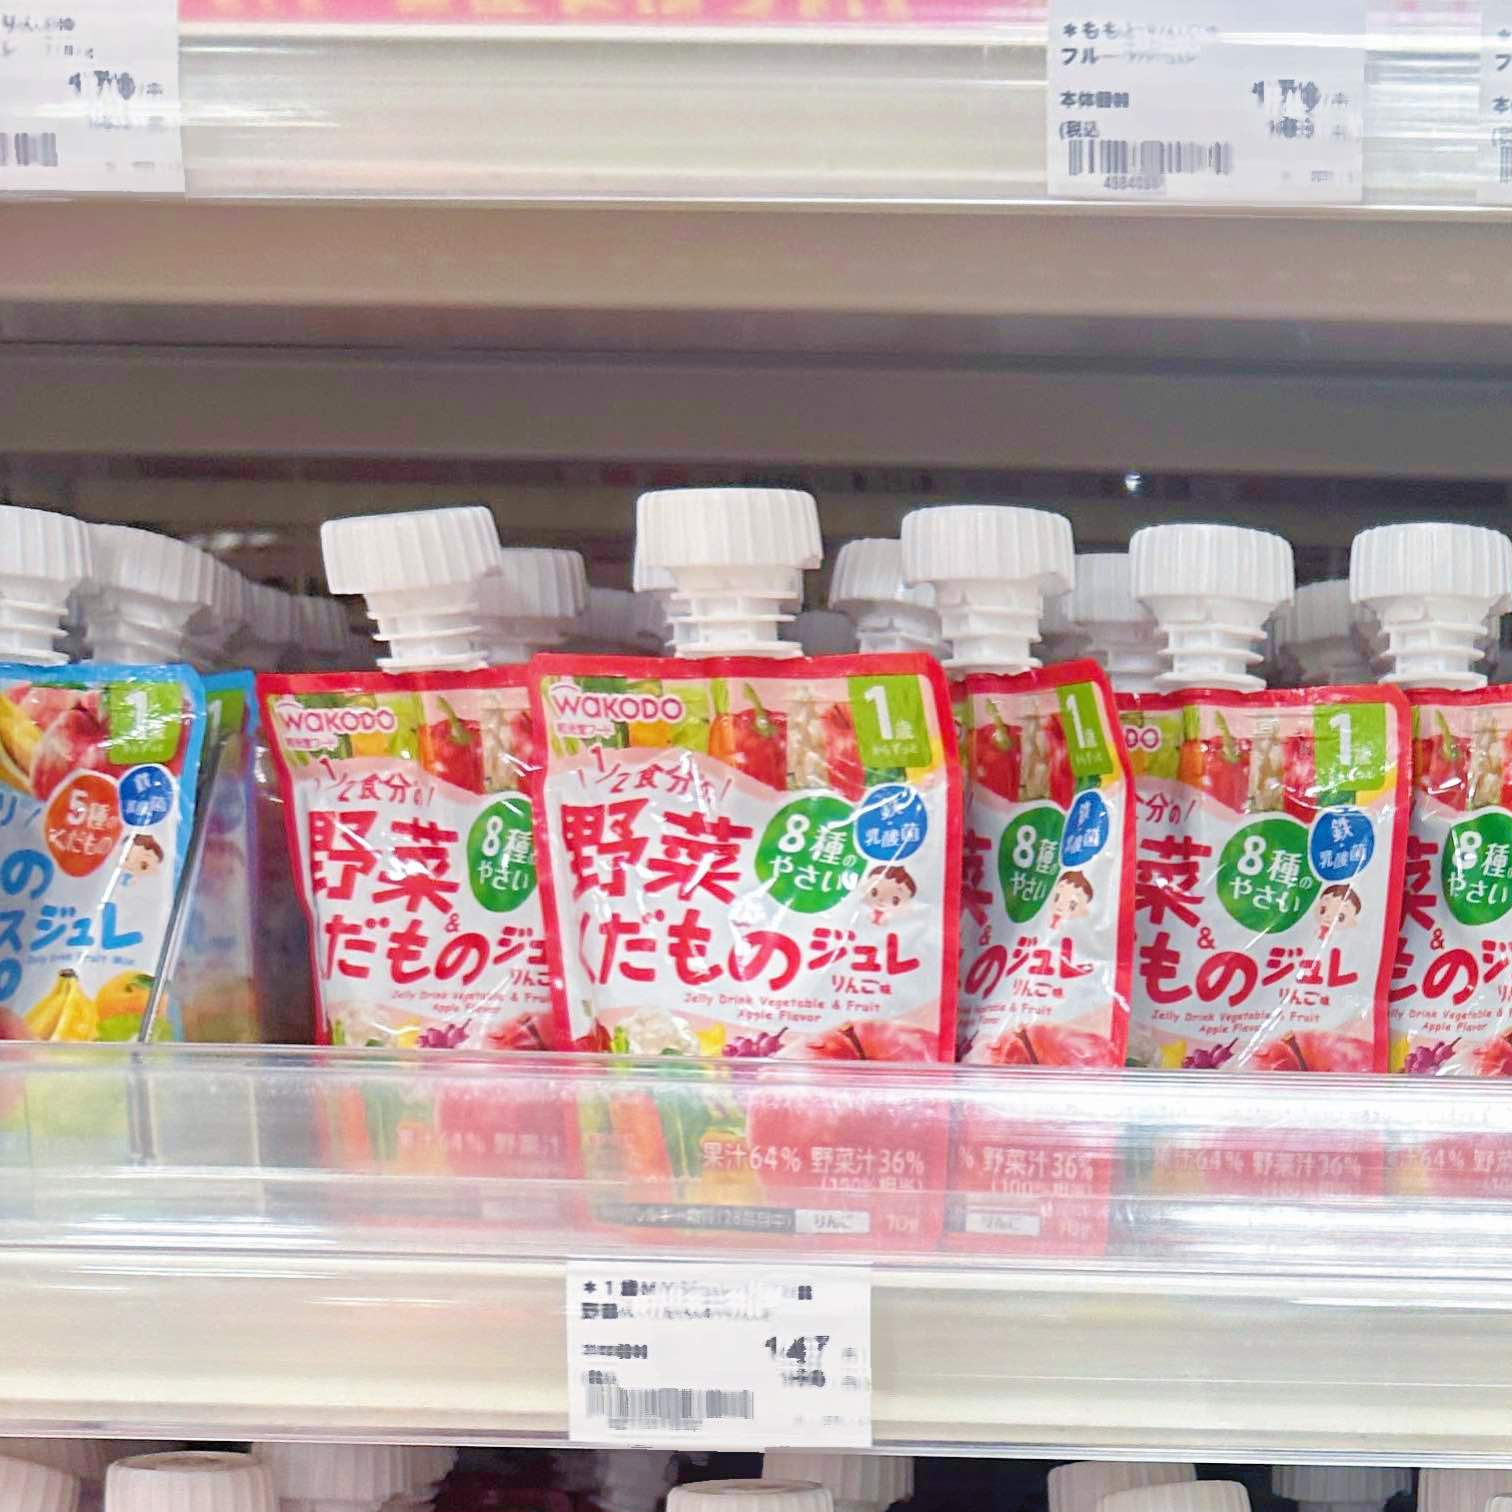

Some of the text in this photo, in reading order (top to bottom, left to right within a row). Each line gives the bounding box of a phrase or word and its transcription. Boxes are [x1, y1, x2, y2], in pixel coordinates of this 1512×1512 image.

[561, 798, 753, 904] 野菜
[778, 814, 855, 866] 8種の
[865, 824, 919, 850] 乳酸菌
[309, 811, 460, 913] 野菜
[478, 860, 529, 890] やさい
[770, 858, 857, 892] やさい
[1237, 835, 1312, 890] 8種の
[1319, 847, 1368, 869] 乳酸菌
[1136, 835, 1211, 927] 菜
[1229, 877, 1299, 913] やさい
[810, 1146, 925, 1175] 野菜汁36%
